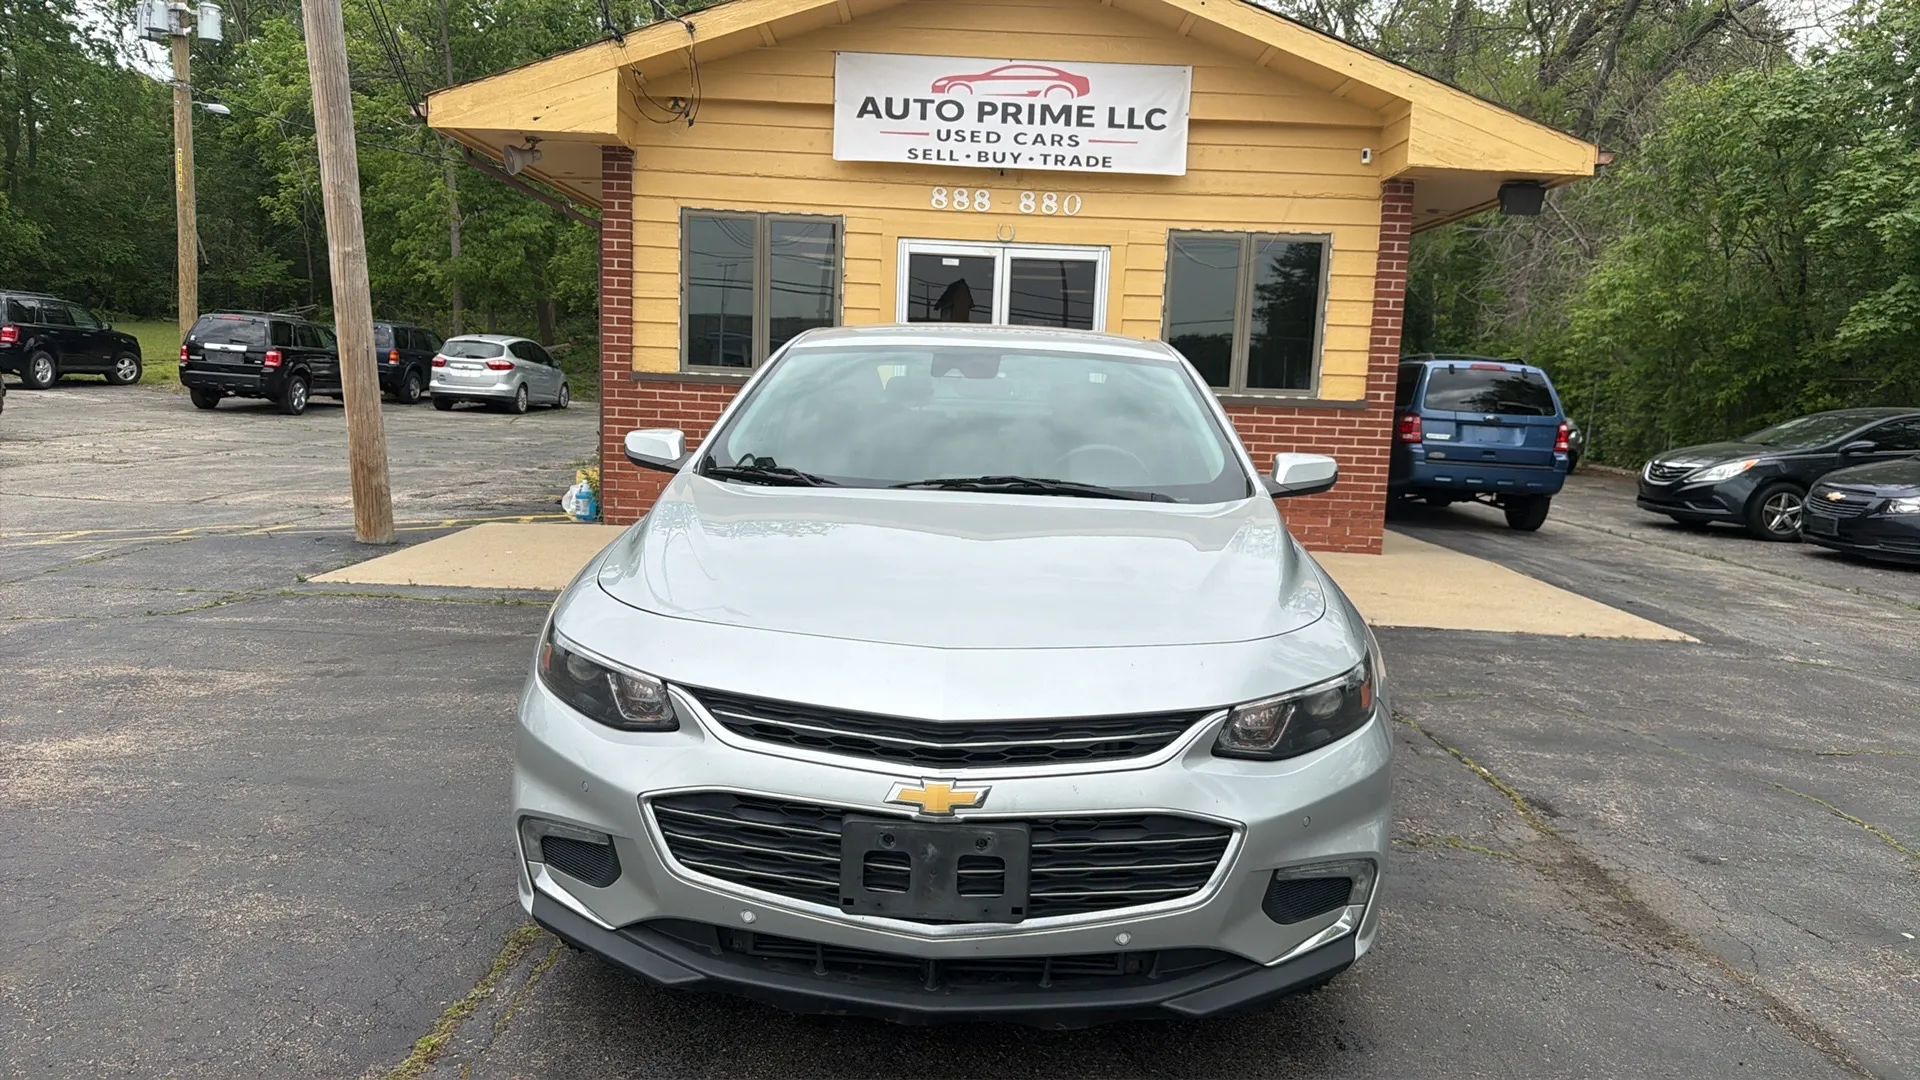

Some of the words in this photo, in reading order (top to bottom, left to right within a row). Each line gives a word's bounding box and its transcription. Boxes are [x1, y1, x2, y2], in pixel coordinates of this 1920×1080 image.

[856, 96, 965, 123] AUTO
[977, 101, 1096, 129] PRIME
[1107, 106, 1168, 131] LLC
[936, 128, 1002, 145] USED
[1013, 132, 1081, 148] CARS
[907, 147, 960, 162] SELL
[977, 150, 1023, 165] BUY
[1039, 153, 1113, 169] TRADE
[931, 186, 991, 212] 888
[1018, 190, 1082, 217] 880
